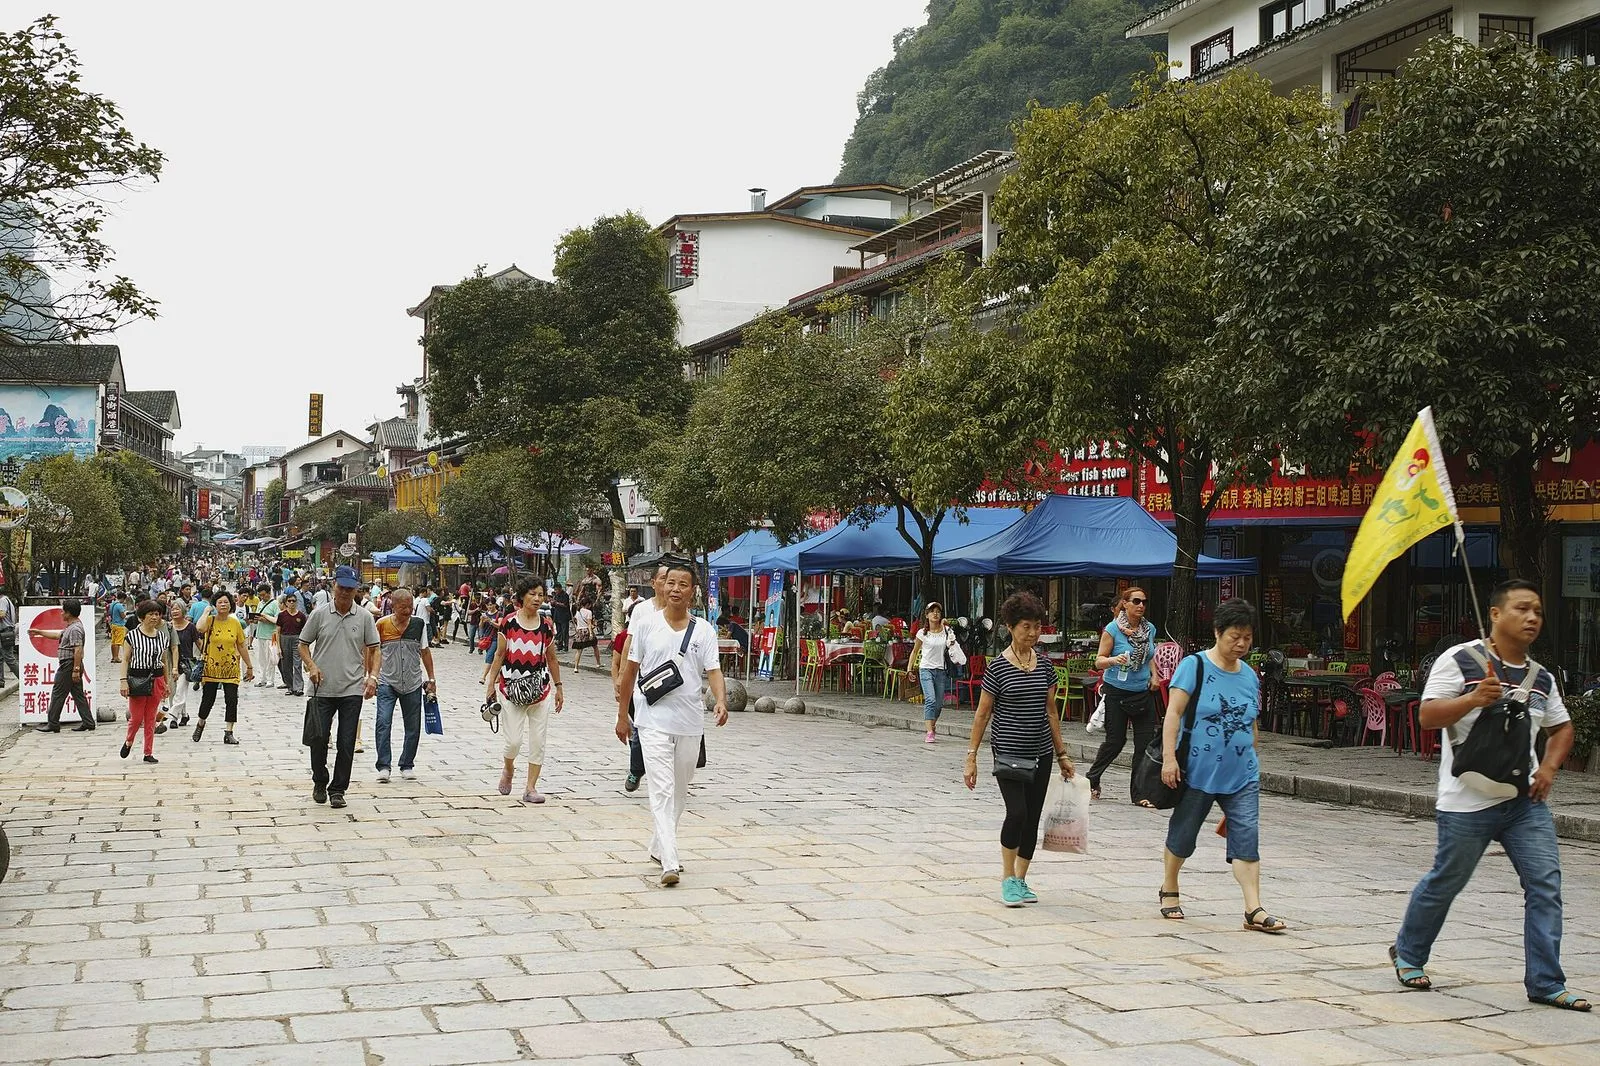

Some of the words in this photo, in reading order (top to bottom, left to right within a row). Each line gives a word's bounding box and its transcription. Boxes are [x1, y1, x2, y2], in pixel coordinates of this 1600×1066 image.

[106, 394, 118, 428] 西街酒店
[1081, 467, 1099, 481] fish
[1102, 467, 1127, 480] store
[1453, 482, 1499, 503] 金奖得
[23, 662, 92, 686] 禁止
[23, 690, 92, 714] 西街行
